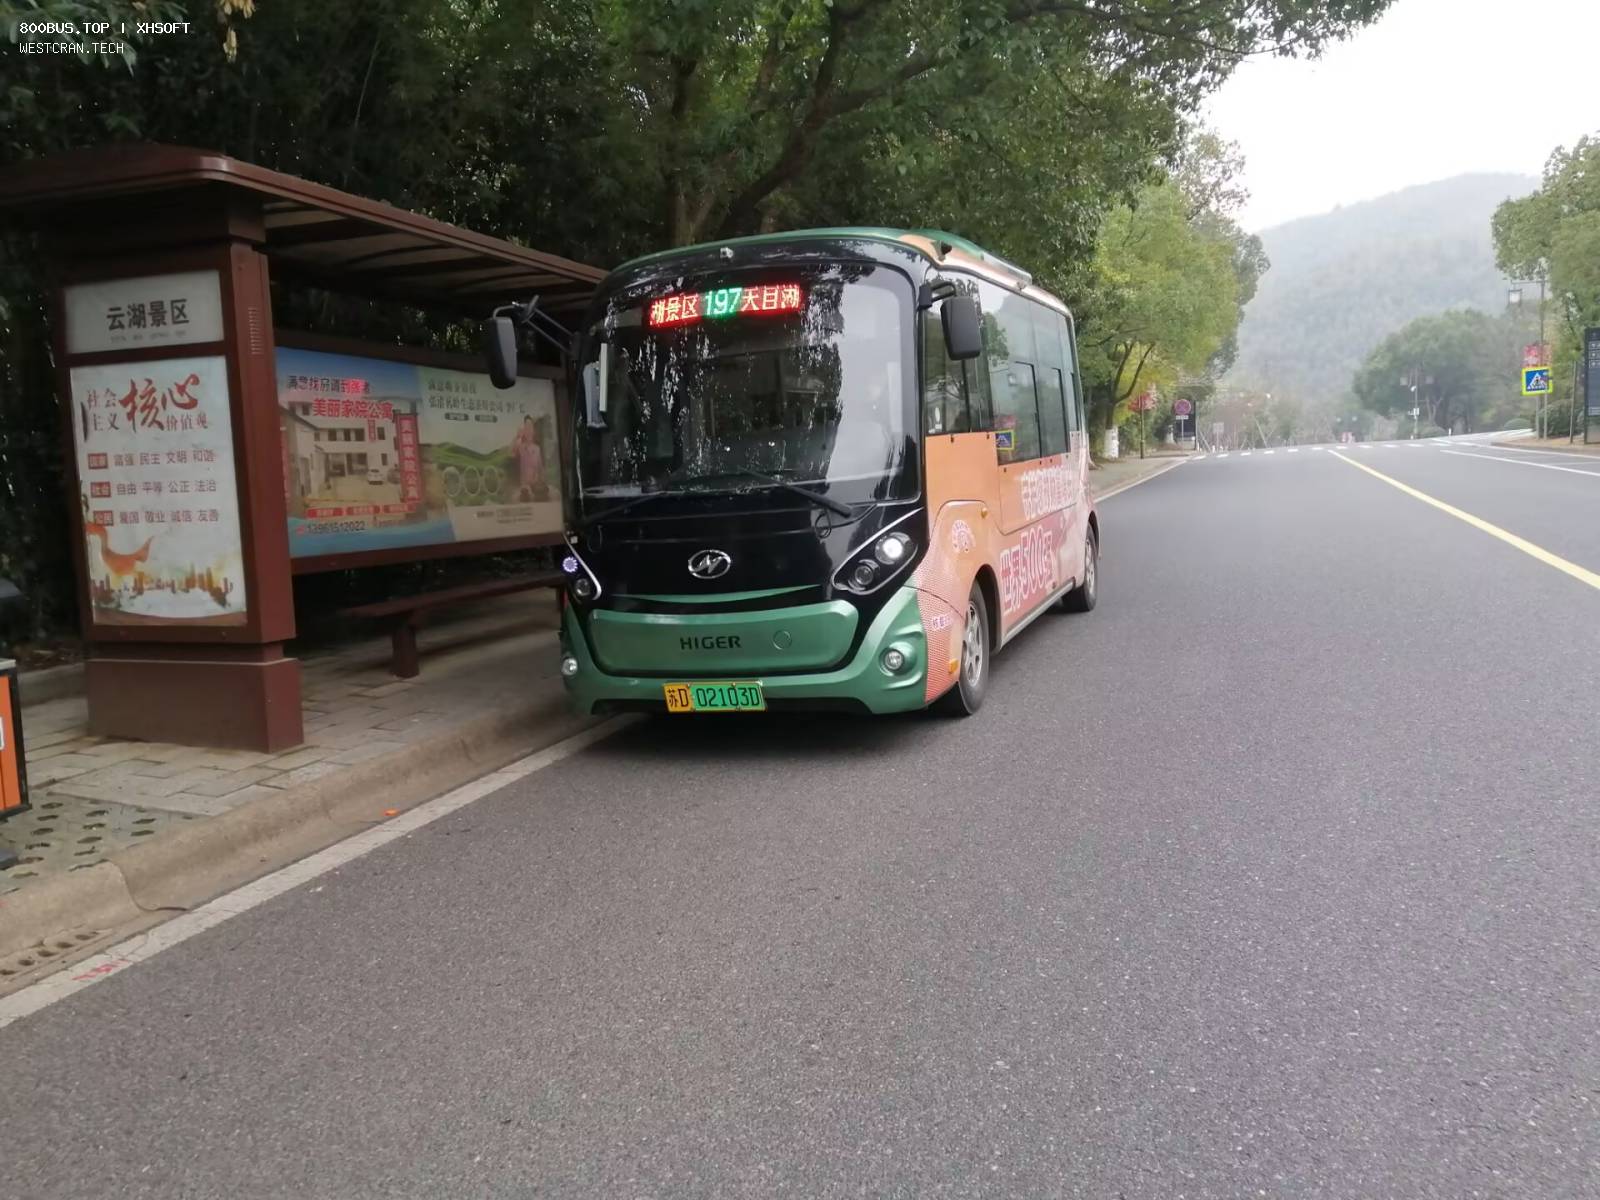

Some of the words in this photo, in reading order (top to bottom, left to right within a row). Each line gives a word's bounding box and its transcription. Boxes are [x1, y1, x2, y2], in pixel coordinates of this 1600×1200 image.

[106, 298, 190, 331] 云湖景区
[649, 294, 700, 326] 湖景区
[705, 287, 743, 316] 197
[741, 284, 801, 312] 天目湖
[87, 387, 117, 409] 社会
[119, 373, 201, 433] 核心
[313, 397, 393, 419] 美丽家院公寓
[92, 412, 121, 431] 主义
[166, 411, 209, 432] 价值观
[113, 453, 135, 467] 富强
[140, 451, 161, 466] 民主
[165, 450, 187, 464] 文明
[192, 448, 216, 463] 和谐
[116, 483, 136, 496] 自由
[142, 481, 163, 496] 平等
[167, 480, 190, 493] 公正
[194, 479, 217, 493] 法治
[119, 511, 140, 525] 爱国
[144, 510, 166, 524] 敬业
[170, 509, 193, 524] 诚信
[196, 508, 219, 523] 友善
[679, 635, 742, 651] HIGER
